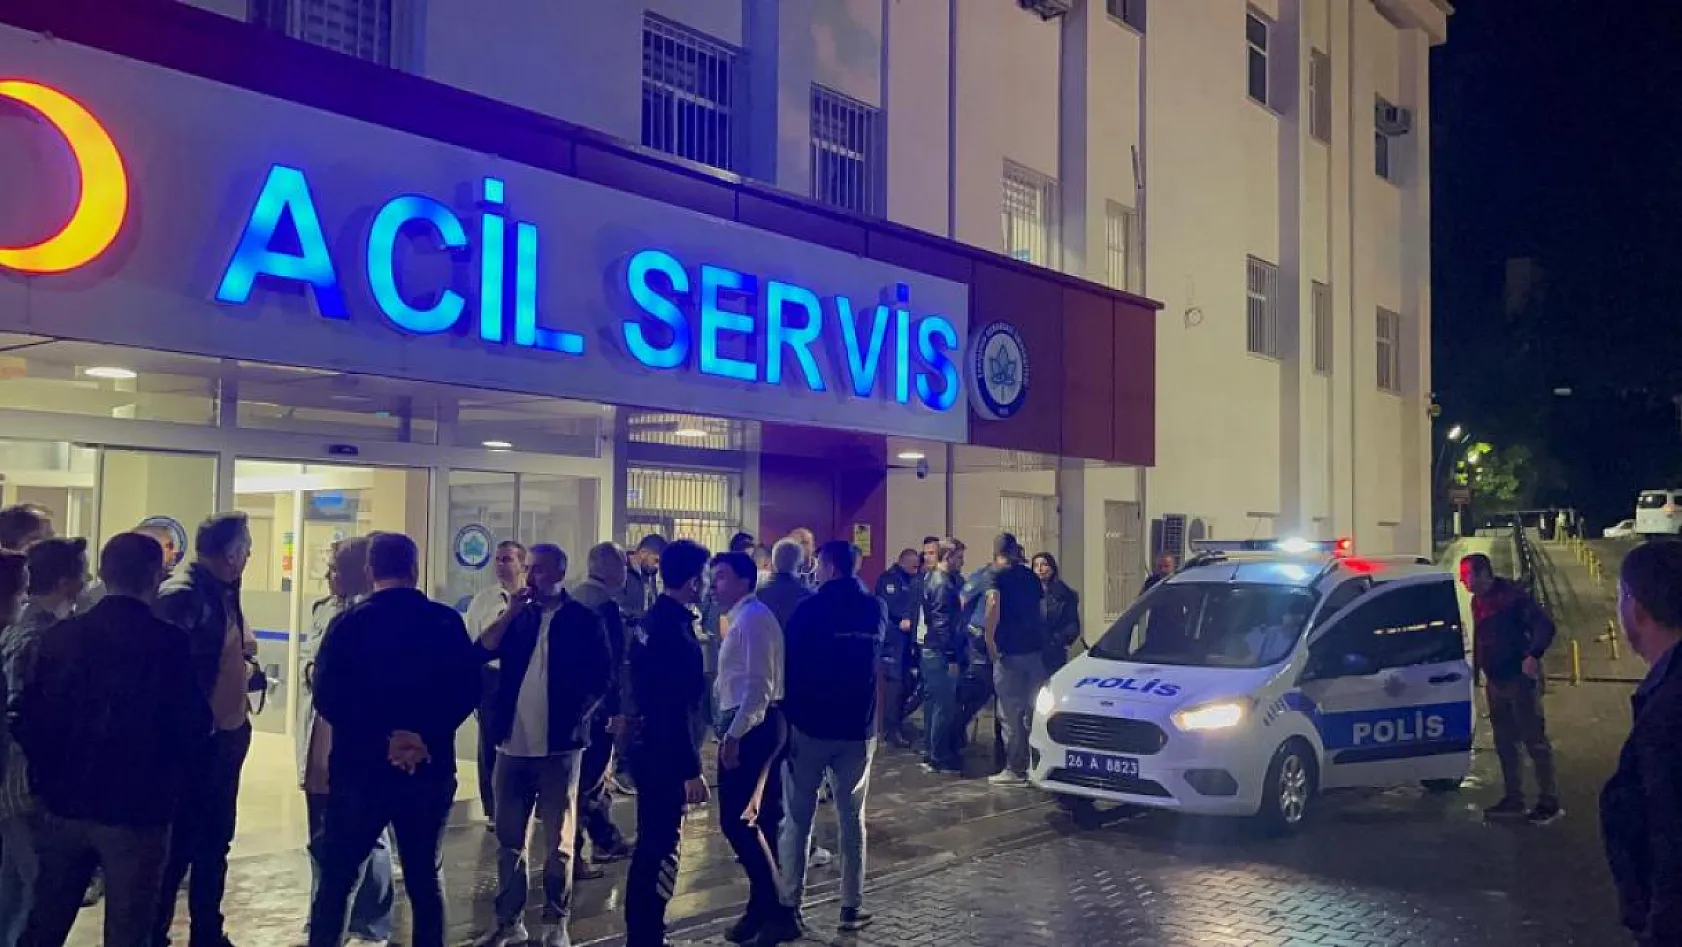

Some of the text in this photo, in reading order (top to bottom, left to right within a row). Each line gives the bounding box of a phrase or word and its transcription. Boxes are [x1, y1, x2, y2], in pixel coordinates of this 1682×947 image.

[216, 163, 584, 354] ACİL
[622, 249, 961, 412] SERVİS
[1074, 677, 1181, 697] POLİS
[1353, 710, 1444, 745] POLİS
[1068, 754, 1084, 768] 26
[1090, 757, 1100, 770] A
